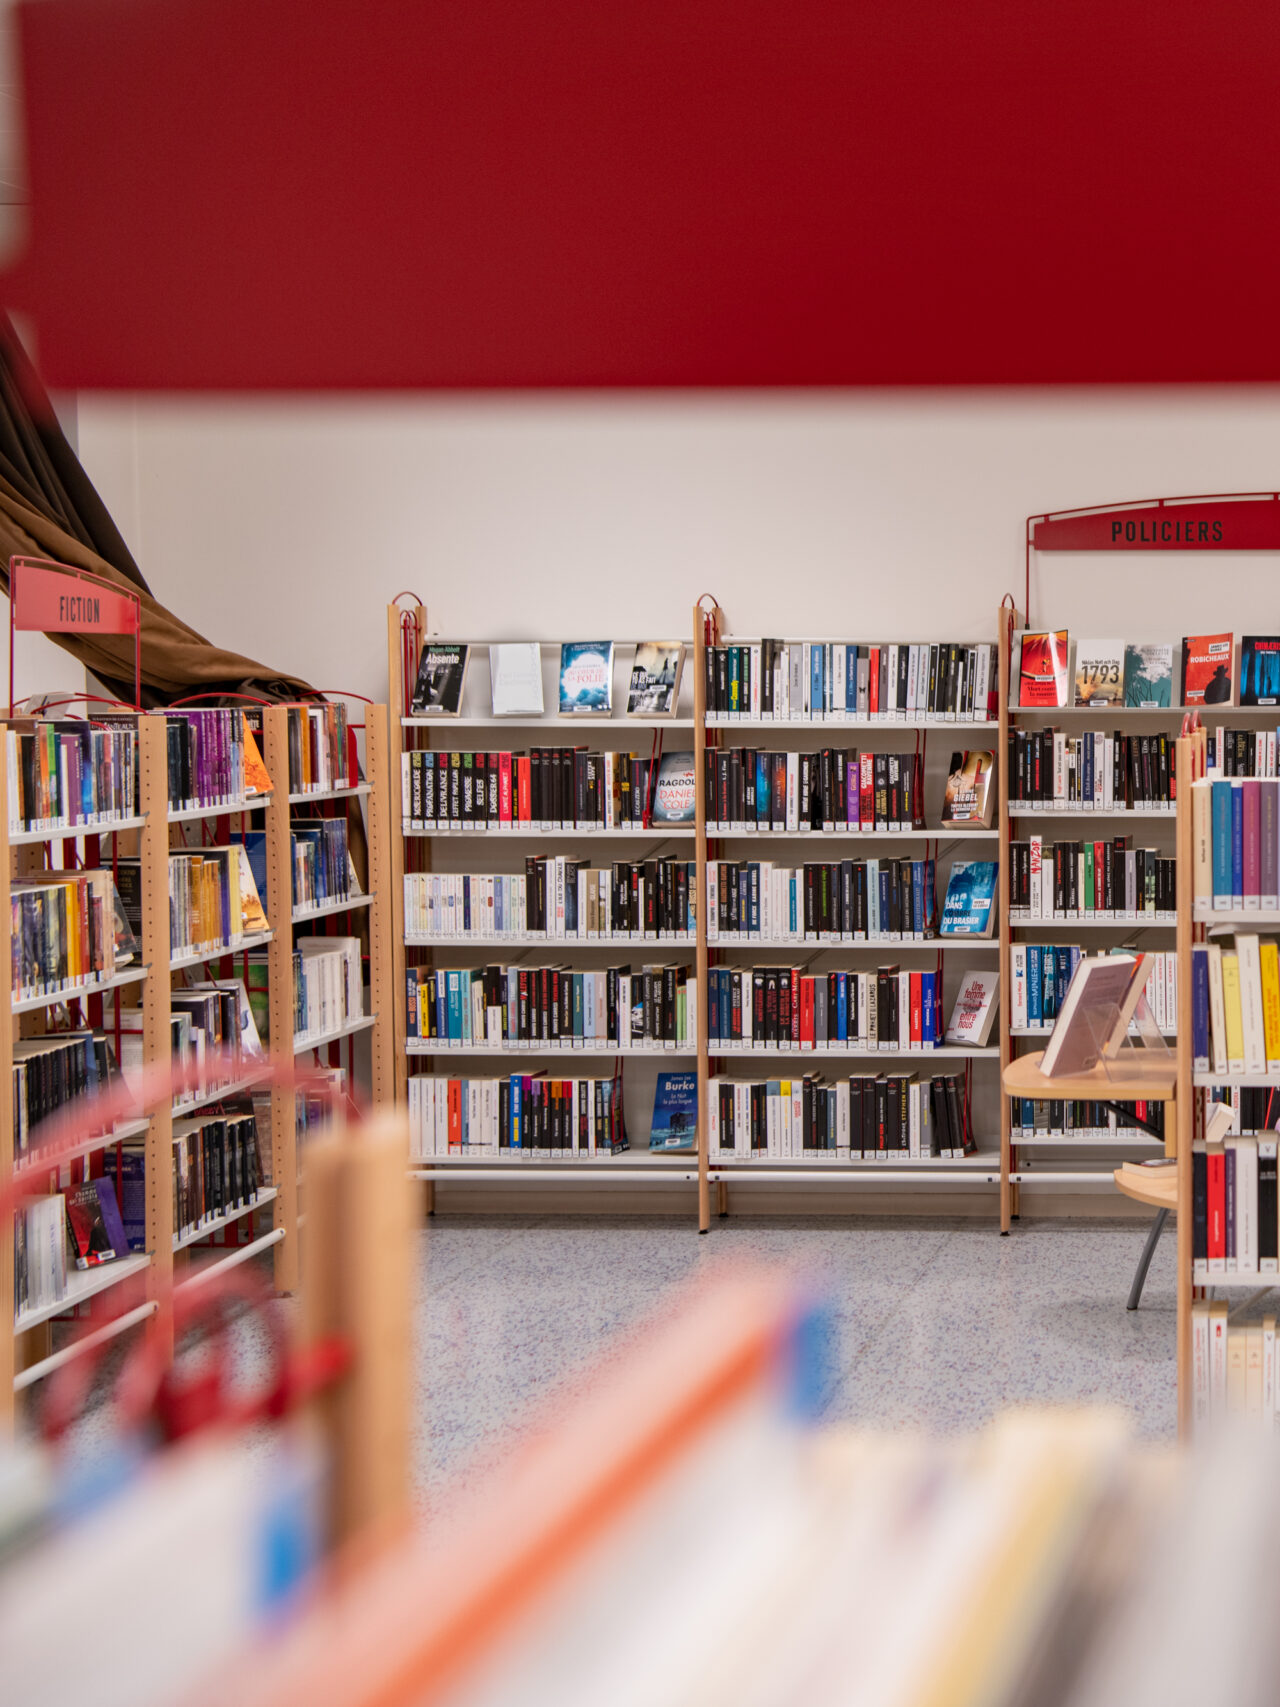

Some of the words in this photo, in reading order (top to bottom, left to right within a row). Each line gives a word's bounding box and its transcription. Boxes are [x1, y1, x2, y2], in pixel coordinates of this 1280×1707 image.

[1111, 520, 1223, 542] POLICIERS
[59, 595, 100, 623] FICTION
[426, 653, 460, 665] Absente
[1190, 654, 1230, 664] ROBICHEAUX
[1082, 665, 1120, 684] 1793
[660, 778, 695, 787] RAGDOL
[664, 800, 690, 810] COLE
[1030, 840, 1042, 874] MANZOR
[972, 980, 984, 992] Une
[1031, 968, 1039, 997] MINIER
[867, 983, 876, 1008] LAZARUS
[964, 988, 986, 999] femme
[960, 1012, 976, 1022] entre
[958, 1020, 974, 1029] nous
[665, 1080, 695, 1090] Burke
